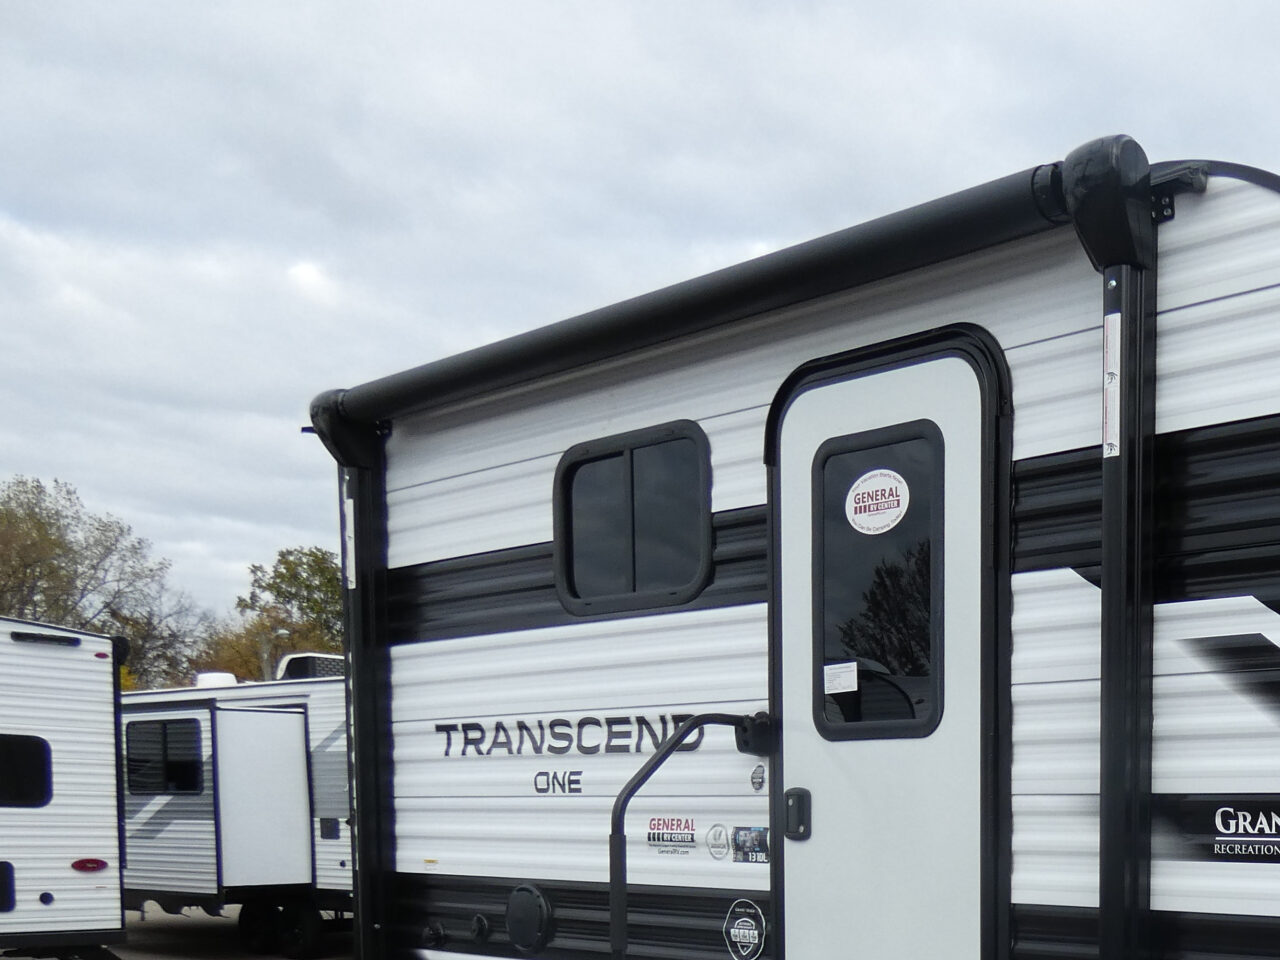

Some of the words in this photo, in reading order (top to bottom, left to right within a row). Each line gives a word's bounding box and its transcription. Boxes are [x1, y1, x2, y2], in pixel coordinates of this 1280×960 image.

[854, 486, 901, 505] GENERAL
[870, 503, 878, 511] RV
[878, 500, 898, 510] CENTER
[435, 713, 705, 756] TRANSCEND
[533, 770, 583, 794] ONE
[649, 817, 696, 832] GENERAL
[663, 833, 672, 842] RV
[671, 833, 693, 842] CENTER
